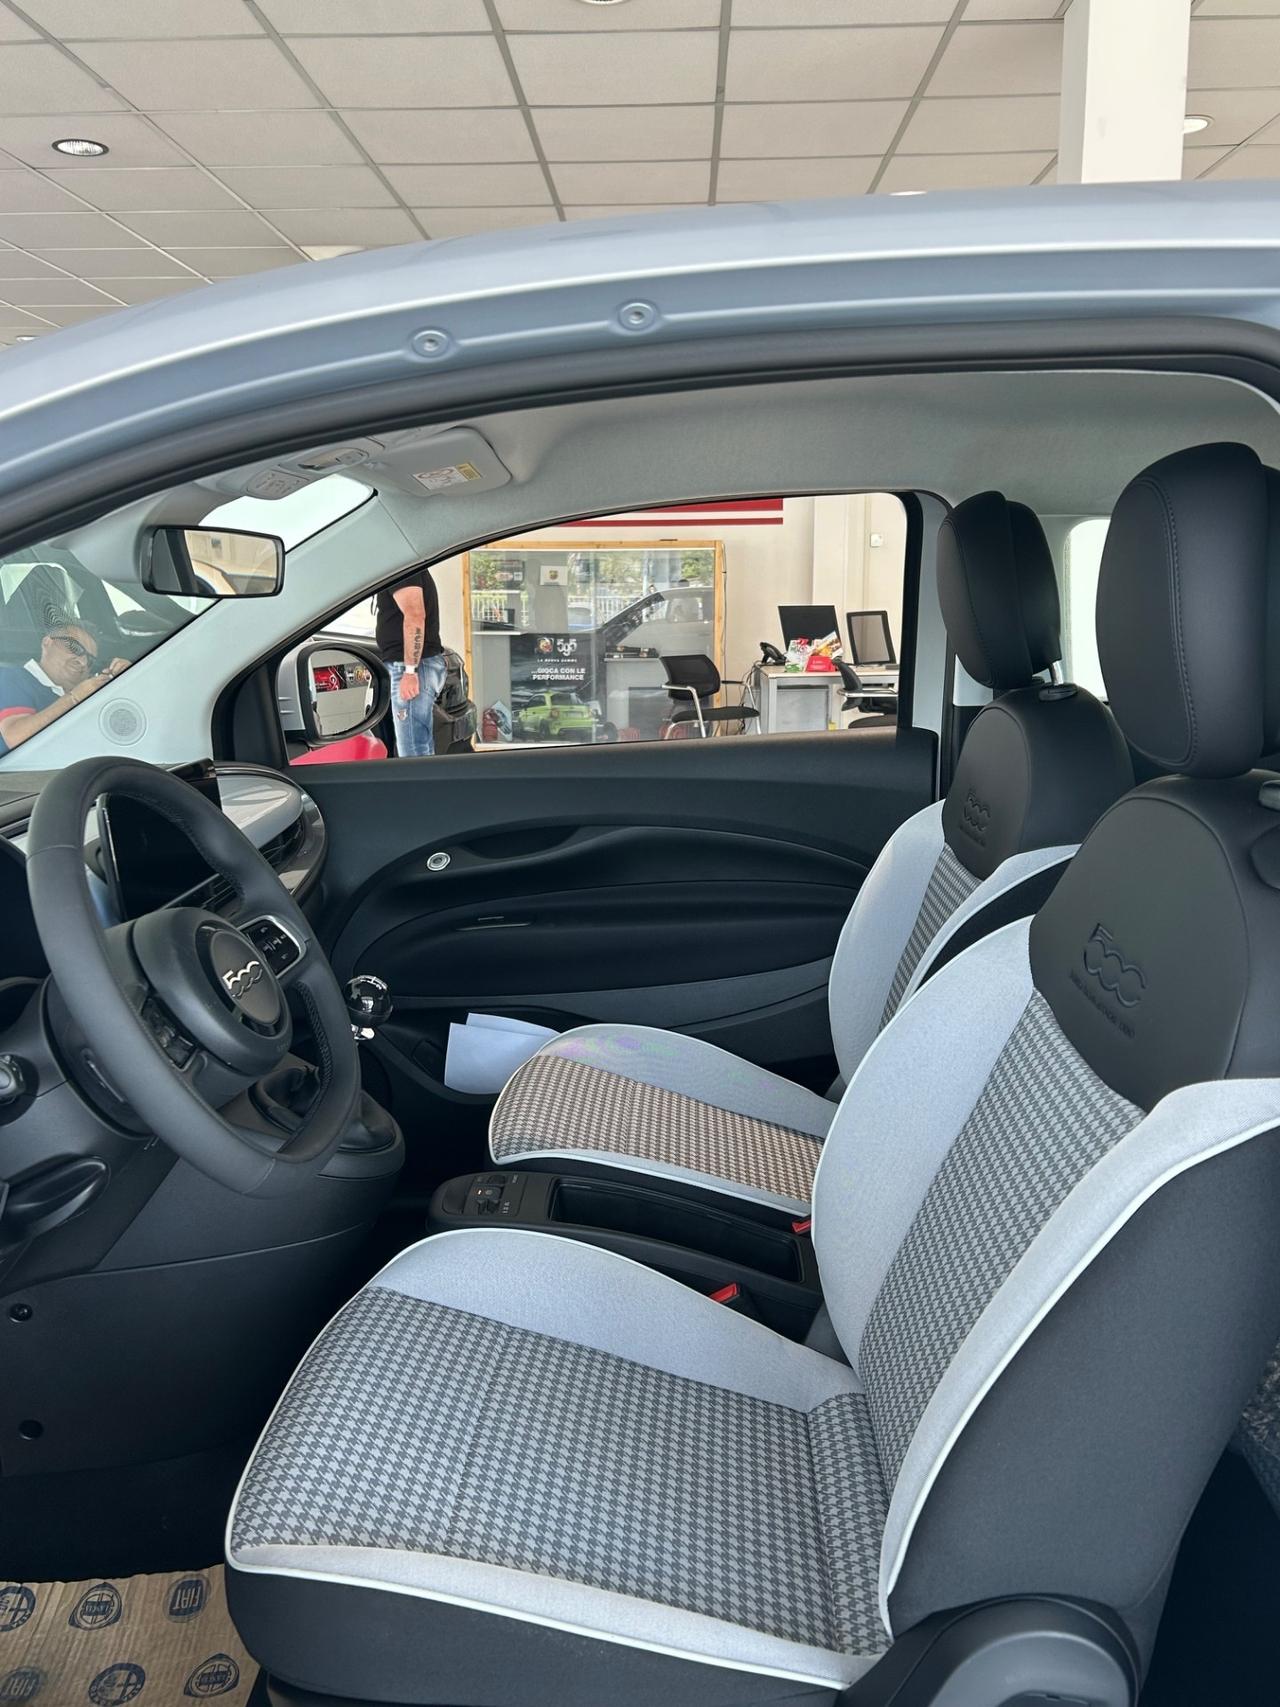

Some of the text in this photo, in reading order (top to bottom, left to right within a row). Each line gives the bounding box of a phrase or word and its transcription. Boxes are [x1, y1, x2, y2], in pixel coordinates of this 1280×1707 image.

[222, 959, 263, 1000] 500
[1083, 923, 1147, 1008] 500
[172, 1586, 201, 1609] FIAT
[3, 1679, 36, 1697] FIAT
